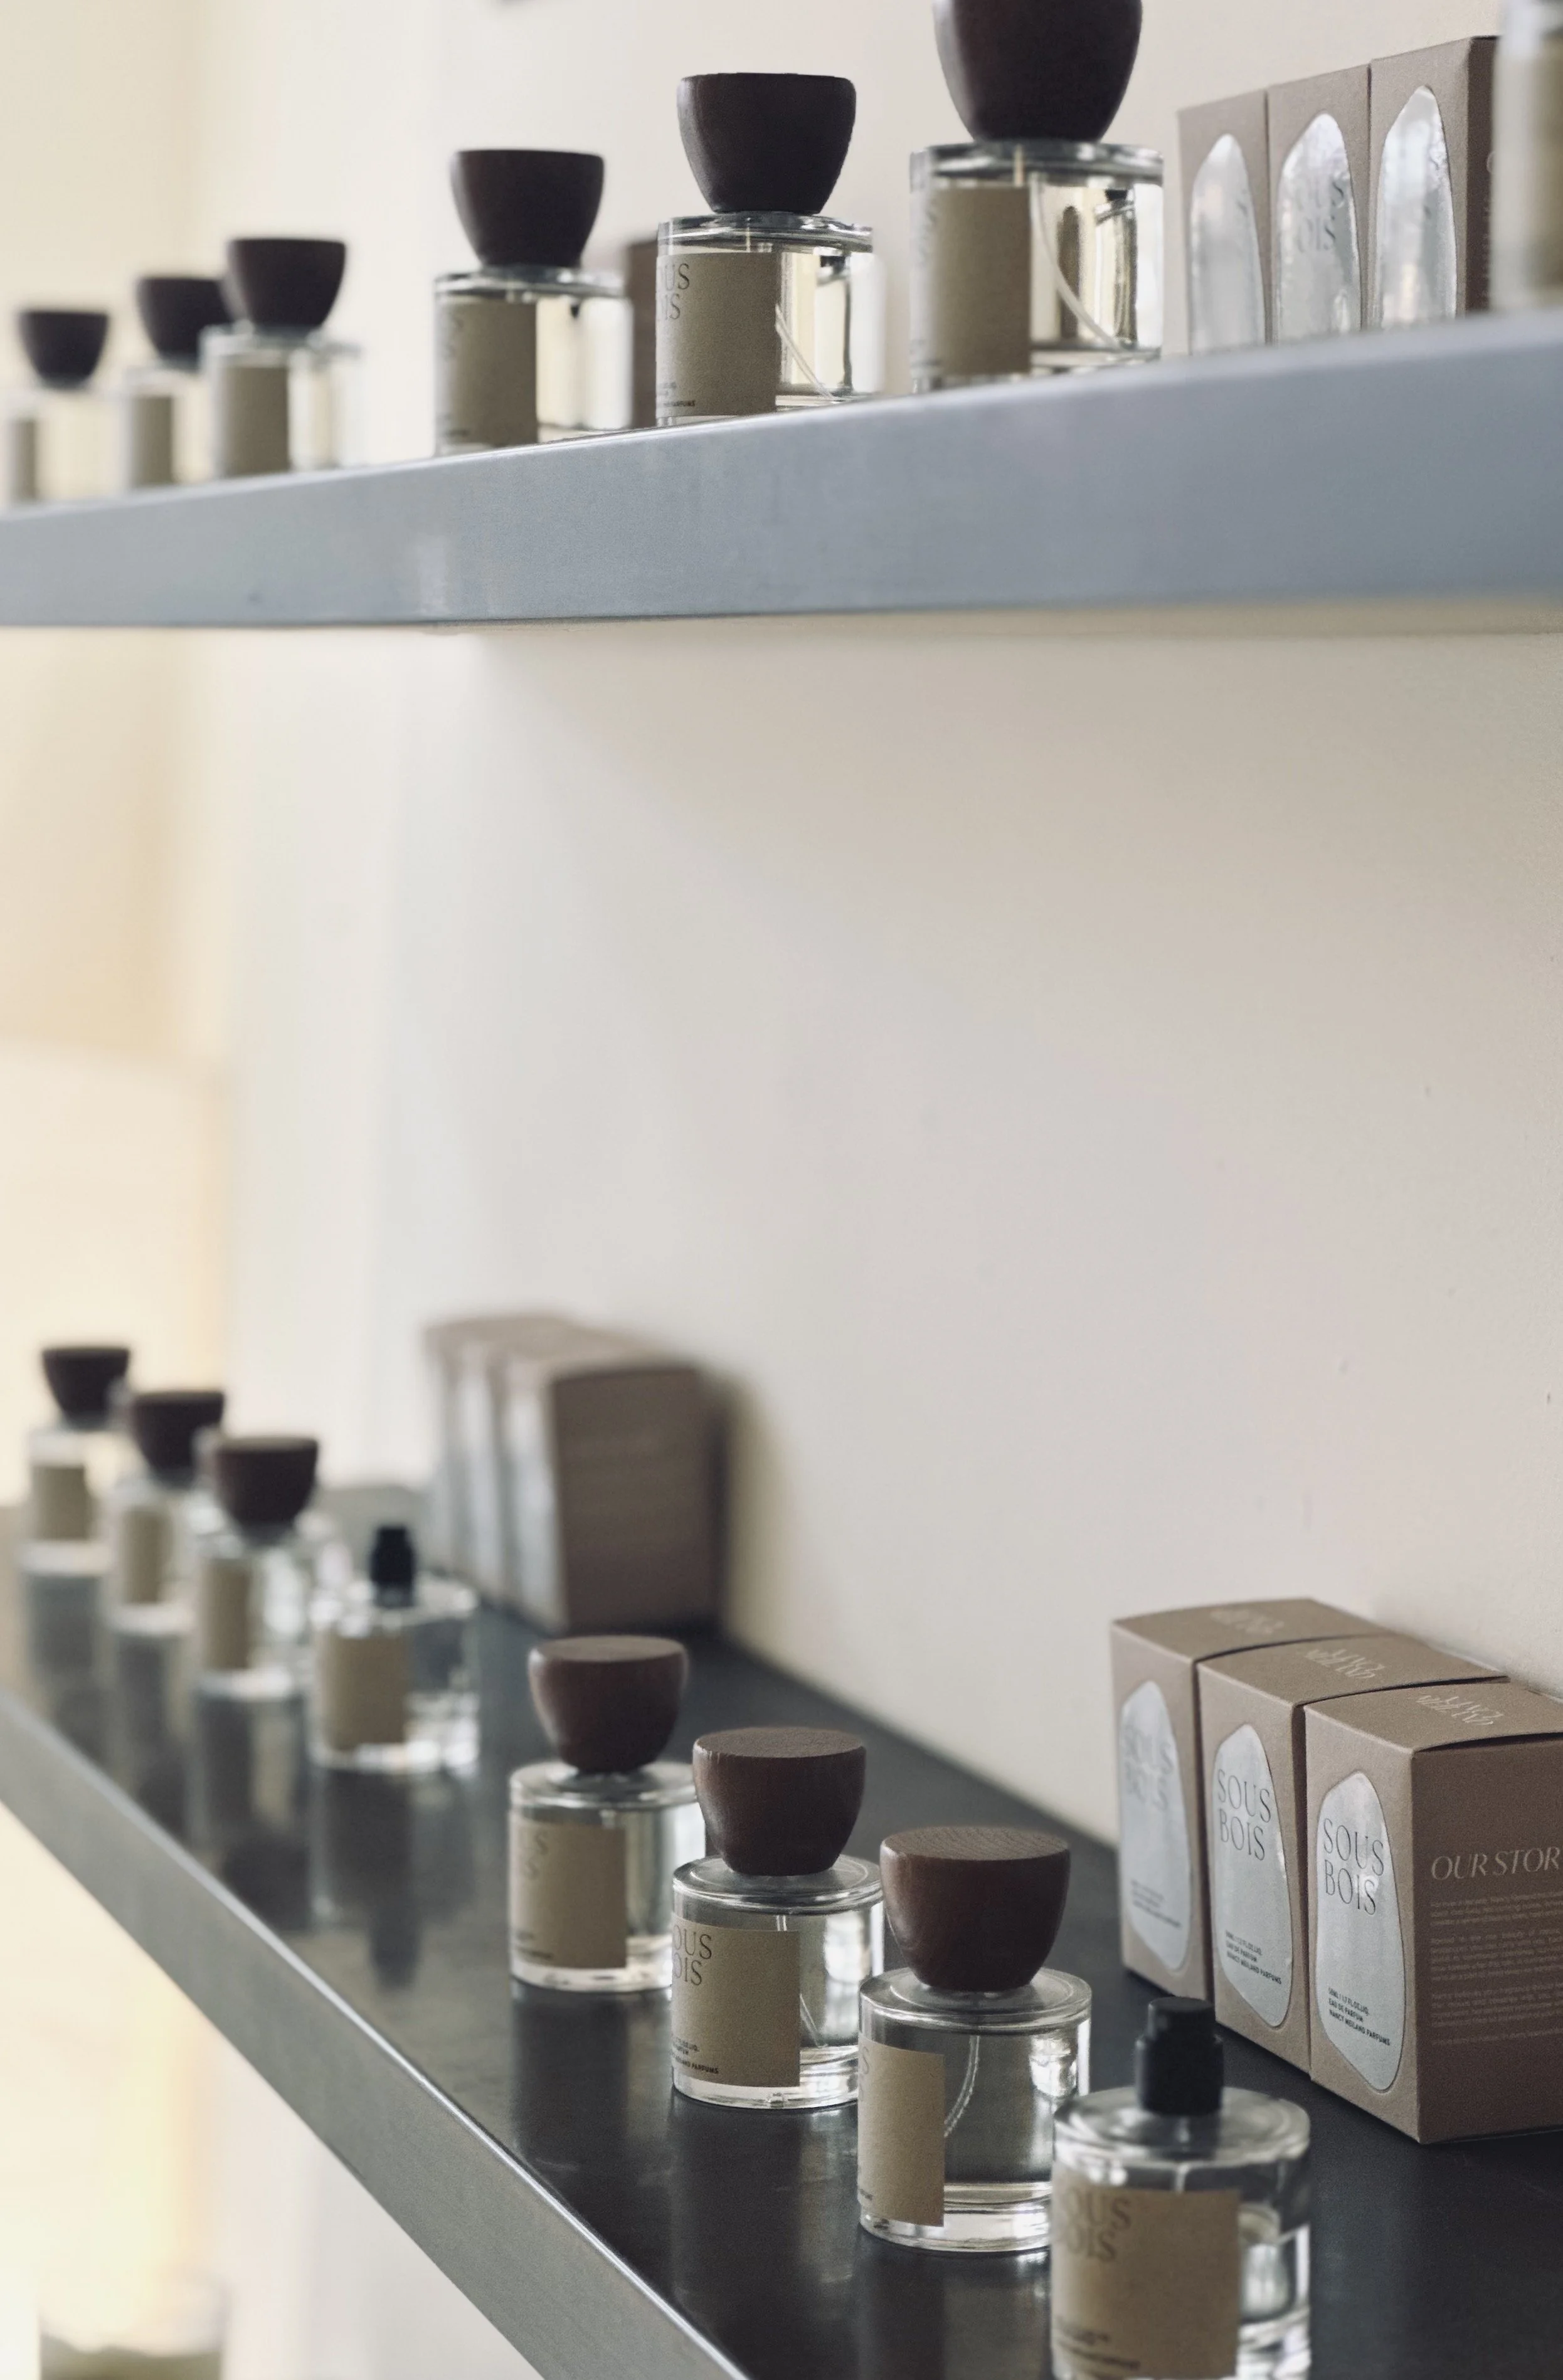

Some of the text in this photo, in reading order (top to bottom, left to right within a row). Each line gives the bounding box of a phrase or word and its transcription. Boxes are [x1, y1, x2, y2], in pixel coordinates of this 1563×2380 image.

[1217, 1769, 1271, 1823] SOUS
[1219, 1808, 1265, 1861] BOIS
[1323, 1818, 1384, 1876] SOUS
[1325, 1859, 1375, 1915] BOIS
[1431, 1853, 1488, 1880] OUR
[1367, 2029, 1390, 2046] PARFUMS
